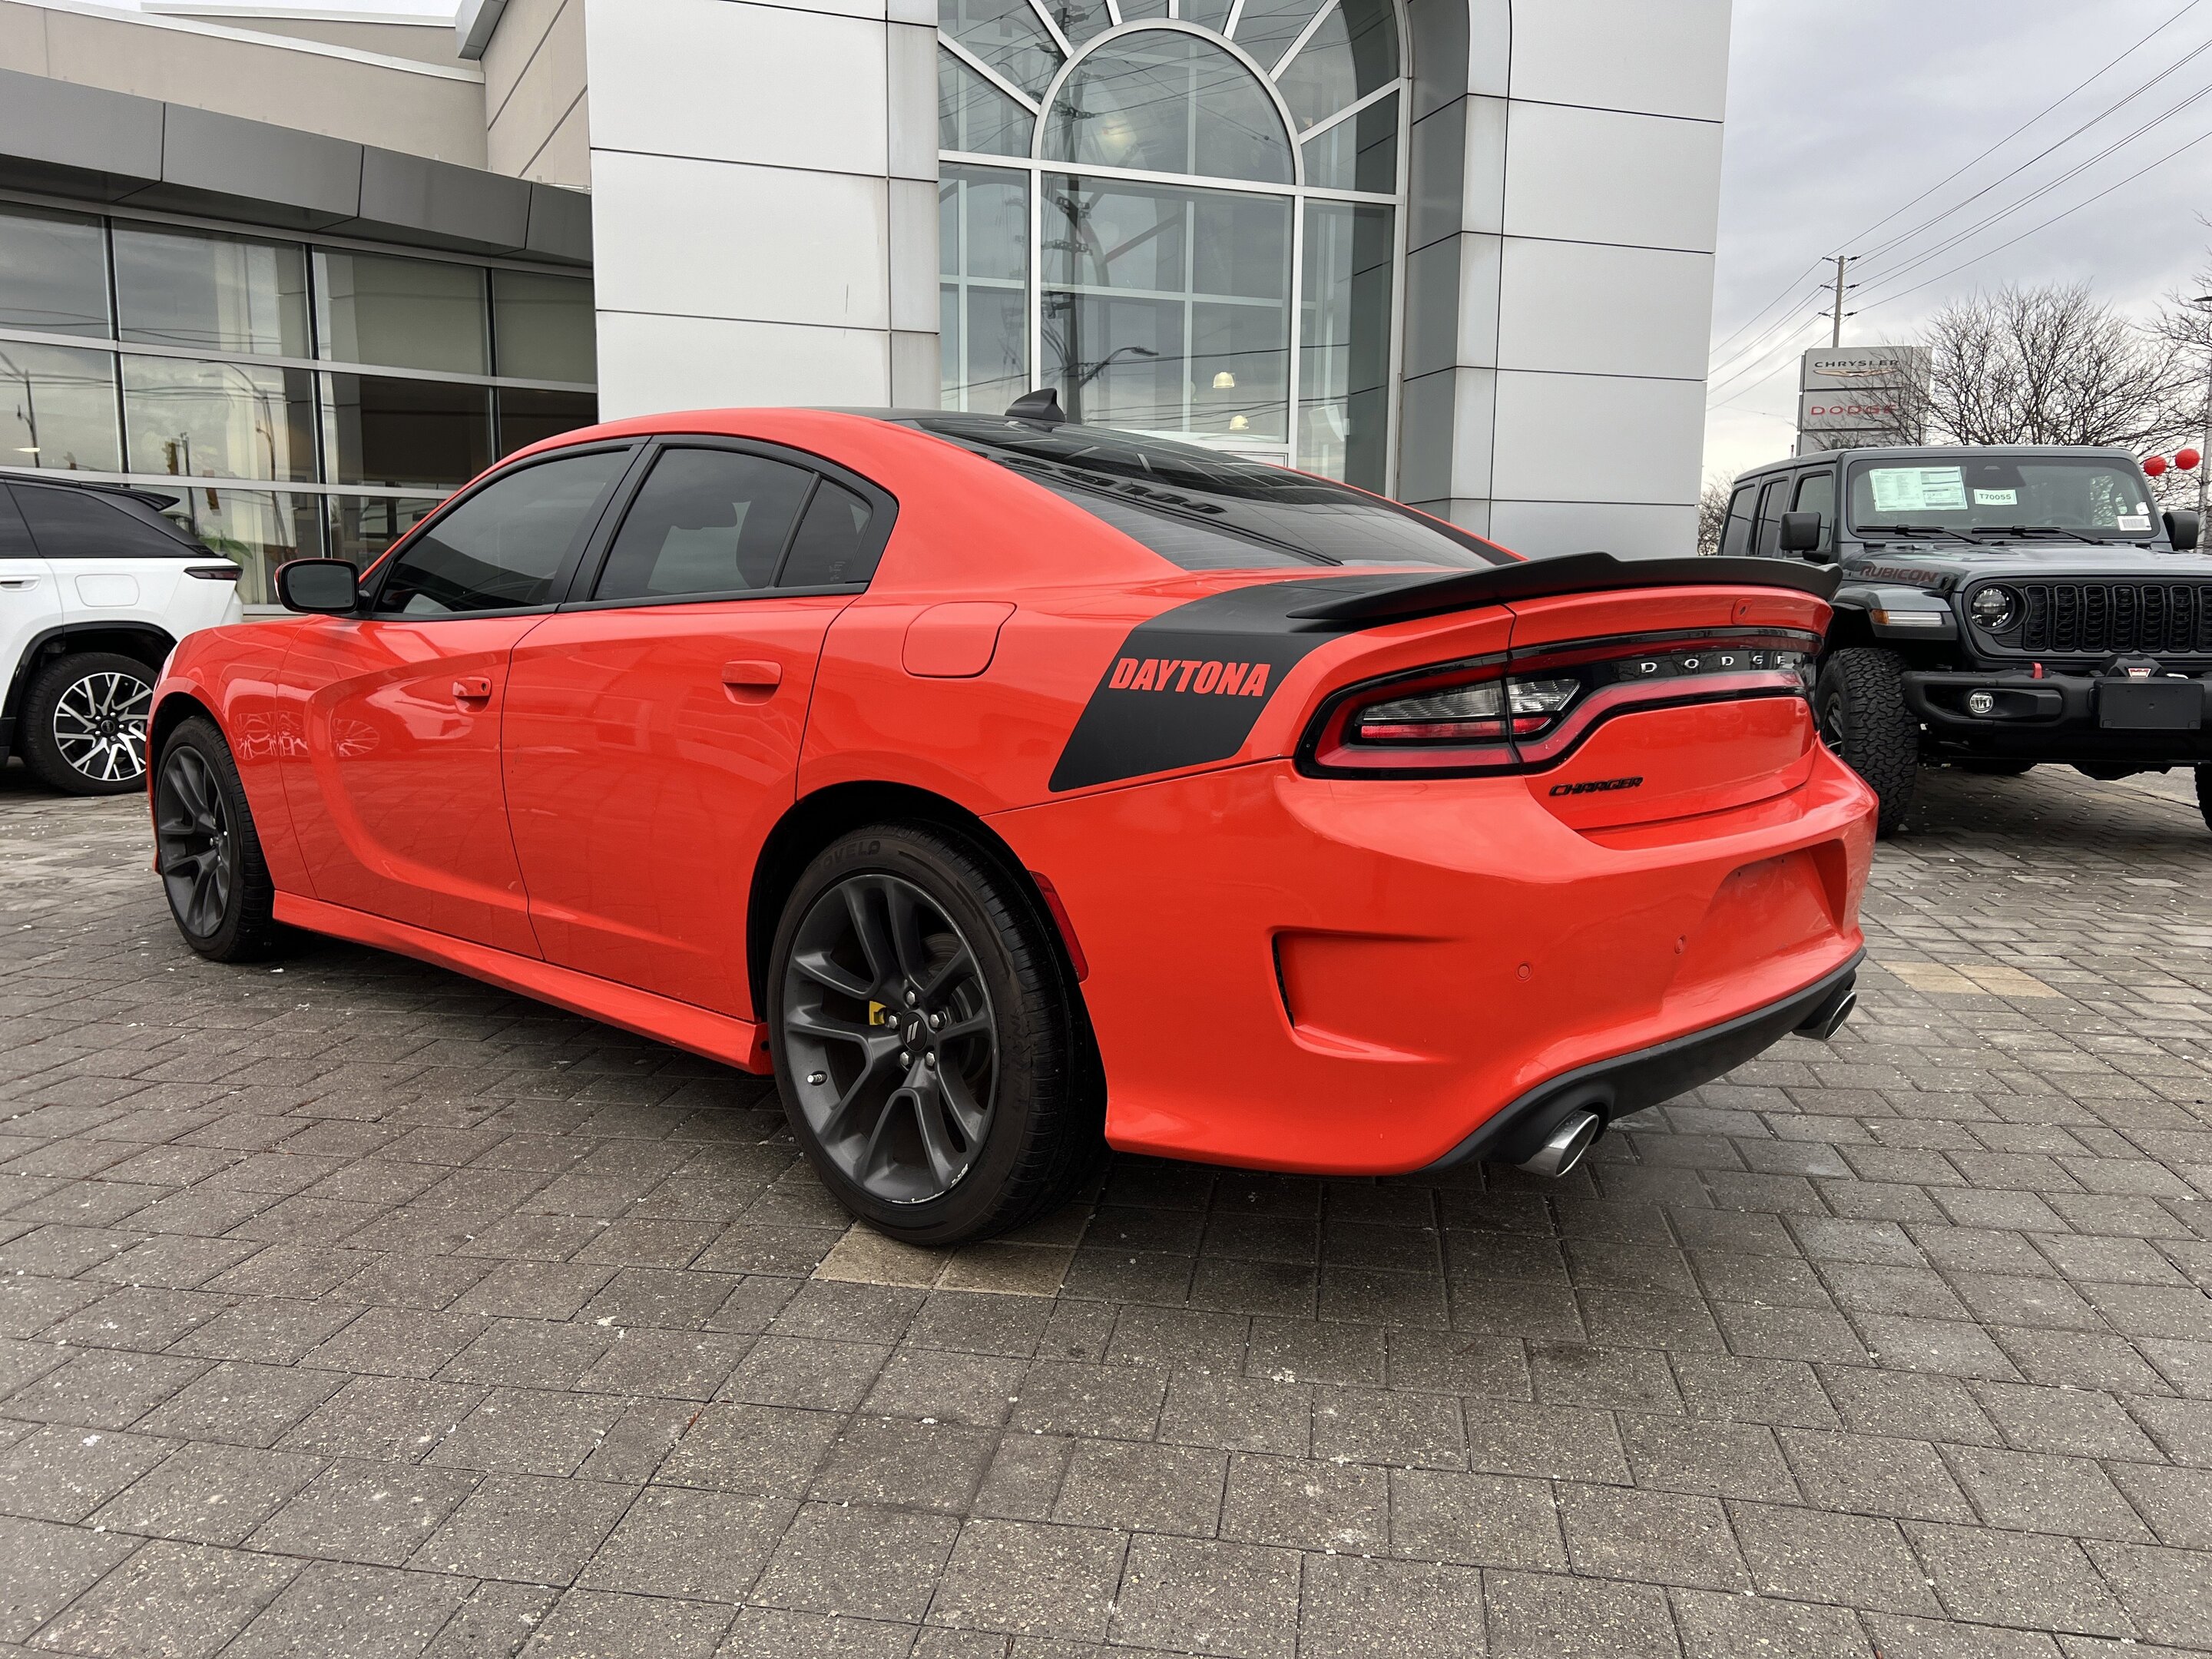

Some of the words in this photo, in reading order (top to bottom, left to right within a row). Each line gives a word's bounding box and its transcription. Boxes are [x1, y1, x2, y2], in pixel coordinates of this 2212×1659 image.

[1814, 359, 1899, 368] CHRYSLER
[1810, 405, 1897, 416] DODGE
[1859, 565, 1939, 583] RUBICON
[1641, 655, 1786, 674] DODGE
[1108, 657, 1271, 697] DAYTONA
[1548, 777, 1644, 796] CHARGER
